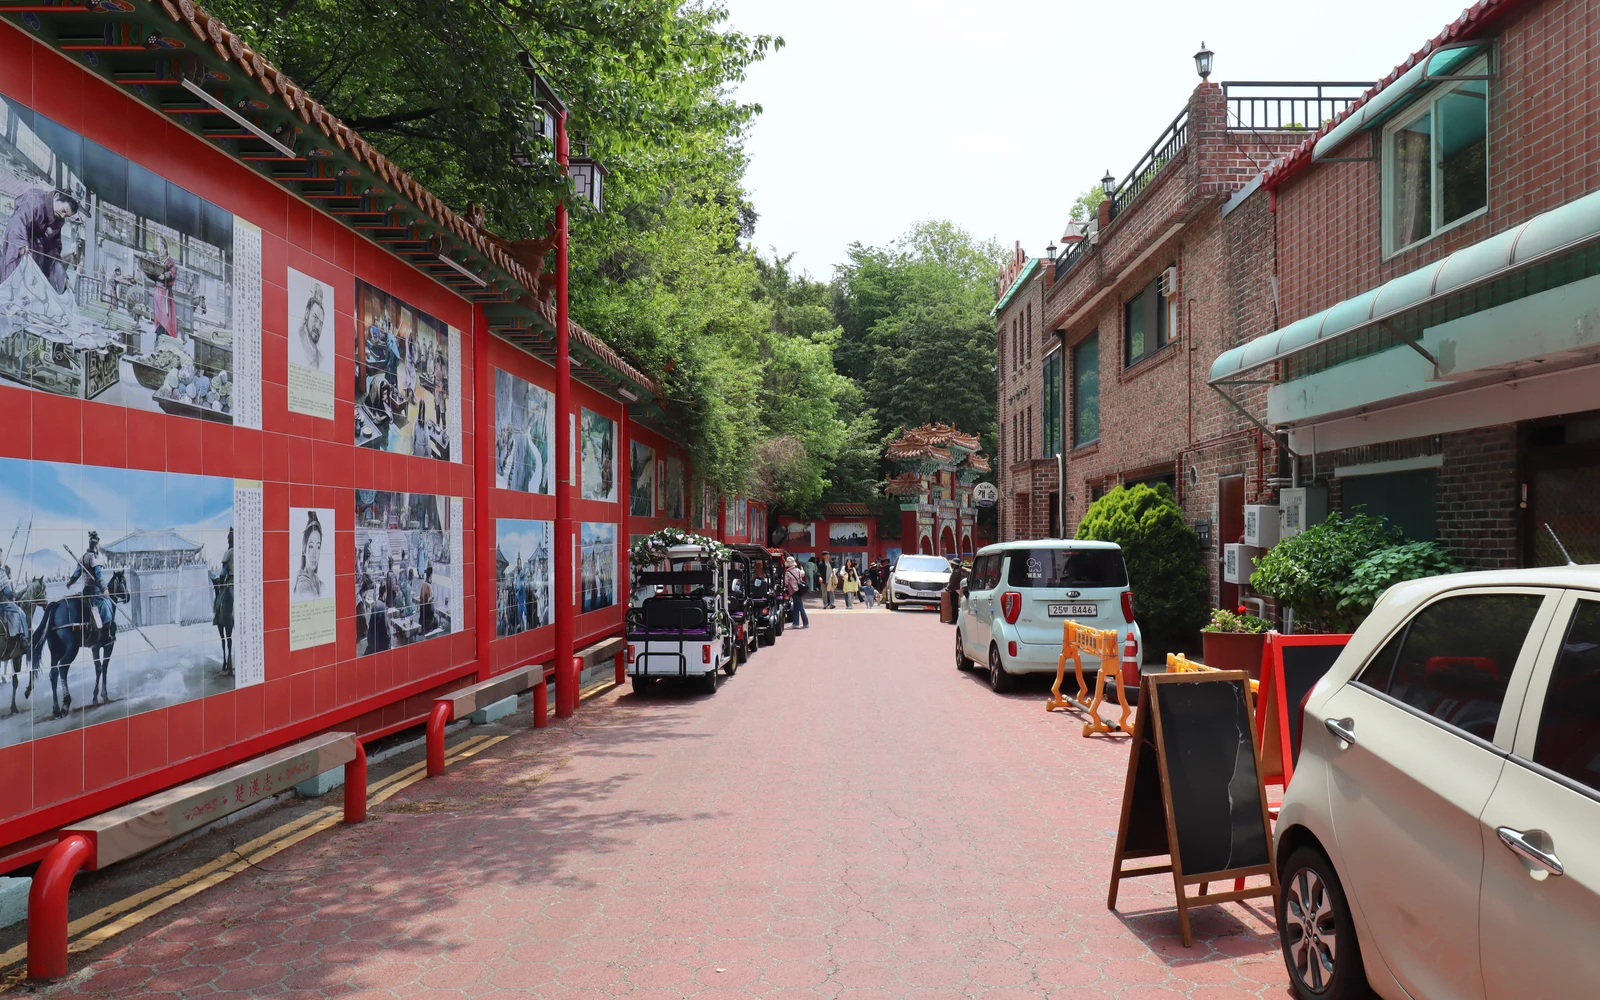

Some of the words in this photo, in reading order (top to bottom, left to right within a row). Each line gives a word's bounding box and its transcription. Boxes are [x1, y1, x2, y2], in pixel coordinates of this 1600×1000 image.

[978, 489, 996, 499] 캐슬
[1072, 606, 1093, 614] 8446
[233, 773, 274, 805] 楚漢志
